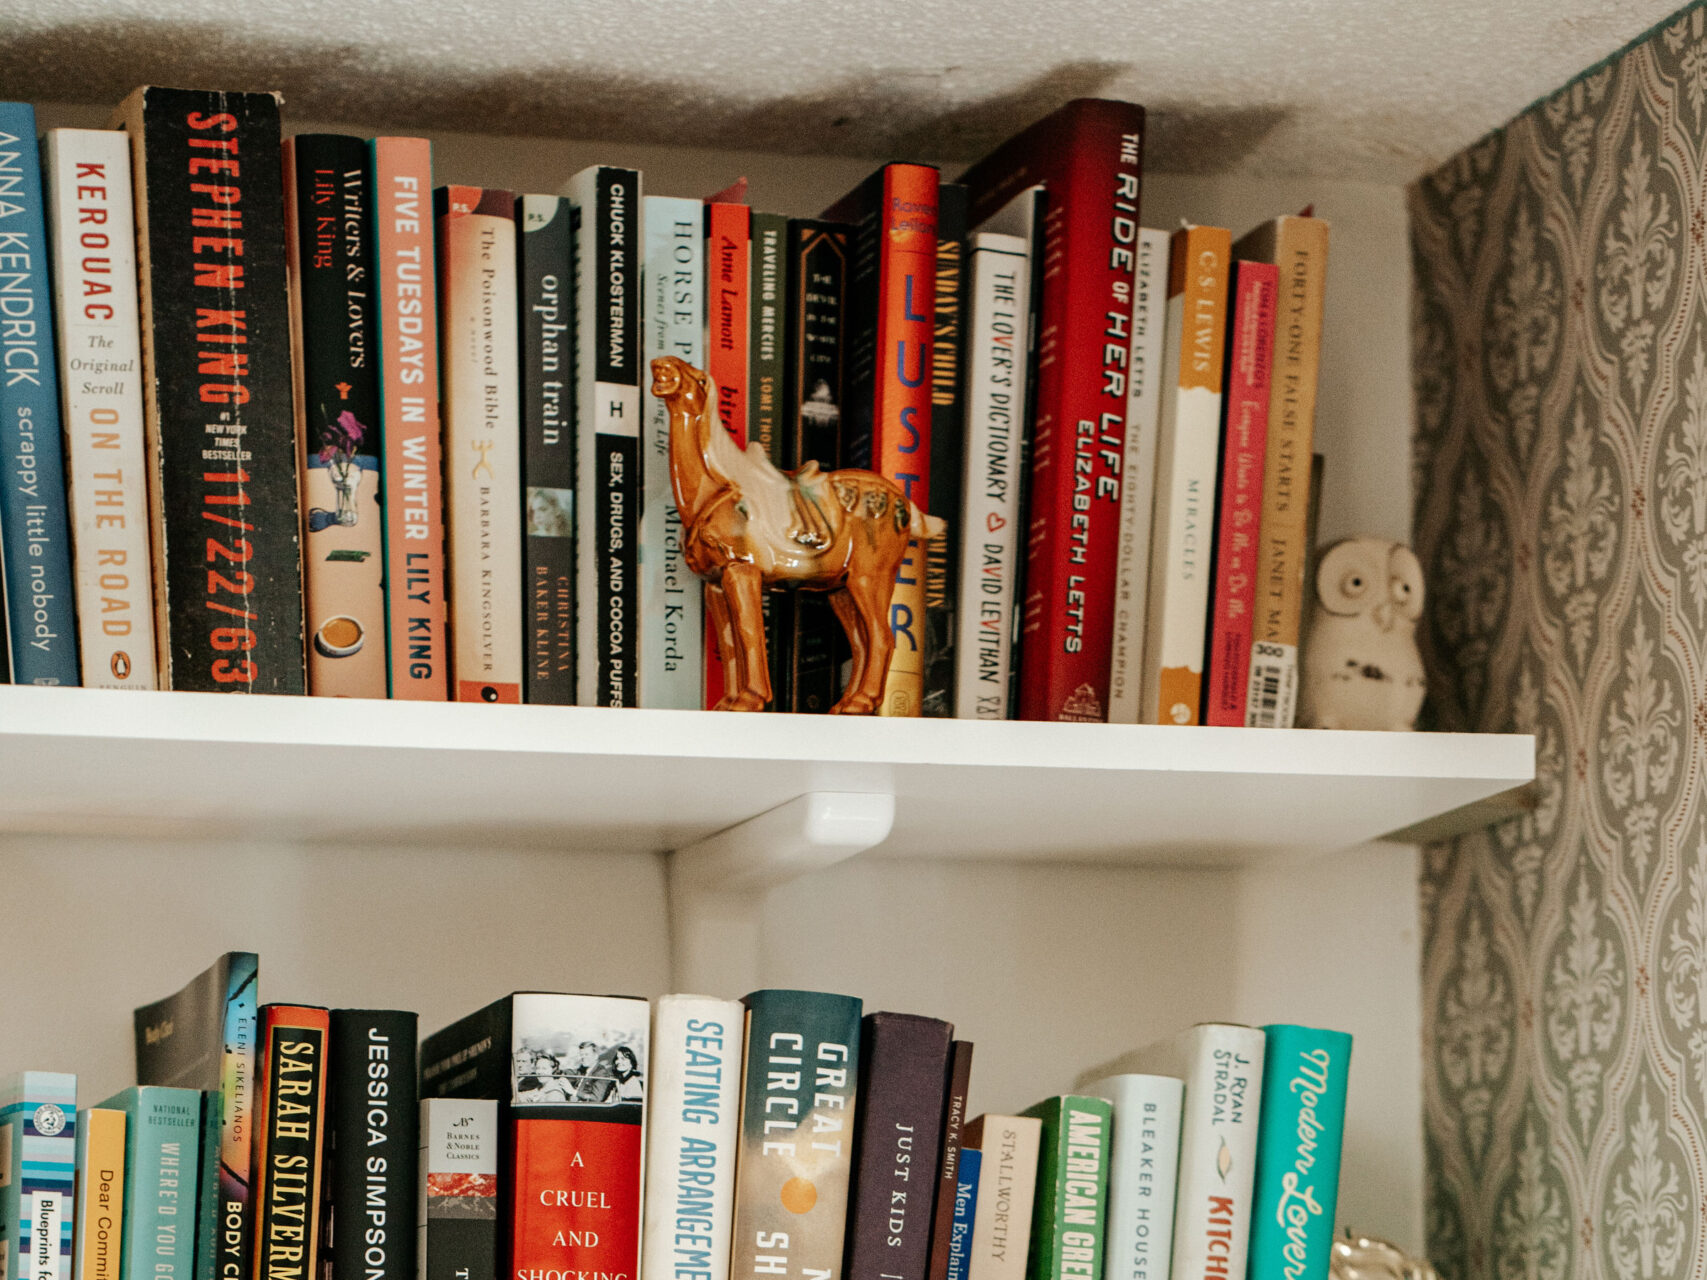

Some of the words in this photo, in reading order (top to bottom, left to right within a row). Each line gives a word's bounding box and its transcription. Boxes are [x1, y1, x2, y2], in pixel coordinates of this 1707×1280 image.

[1120, 134, 1140, 165] THE
[187, 111, 243, 287] STEPHEN
[394, 176, 419, 234] FIVE
[610, 184, 625, 246] CHUCK
[1112, 172, 1139, 273] RIDE
[76, 162, 114, 320] KEROUAC
[761, 230, 777, 301] TRAVELING
[397, 246, 424, 384] TUESDAYS
[610, 250, 625, 367] KLOSTERMAN
[994, 272, 1016, 304] THE
[1112, 281, 1131, 304] OF
[88, 336, 114, 348] The
[533, 274, 567, 372] orphan
[760, 306, 776, 361] MERCIES
[991, 311, 1015, 387] LOVER'S
[1102, 311, 1129, 398] HER
[70, 359, 135, 373] Original
[196, 308, 250, 404] KING
[81, 382, 124, 395] Scroll
[401, 395, 426, 422] IN
[543, 381, 569, 444] train
[16, 407, 38, 497] scrappy
[90, 408, 120, 449] ON
[202, 449, 252, 461] BESTSELLER
[205, 424, 227, 434] NEW
[229, 425, 247, 435] YORK
[214, 436, 240, 447] TIMES
[986, 392, 1011, 503] DICTIONARY
[1097, 412, 1123, 501] LIFE
[94, 469, 126, 529] THE
[402, 436, 429, 540] WINTER
[610, 452, 624, 487] SEX,
[1069, 420, 1095, 565] ELIZABETH
[26, 505, 50, 556] little
[610, 492, 624, 553] DRUGS,
[98, 550, 132, 636] ROAD
[202, 468, 258, 683] 11/22/63
[406, 553, 430, 604] LILY
[610, 557, 624, 591] AND
[981, 543, 1004, 595] DAVID
[31, 565, 57, 651] nobody
[610, 597, 624, 655] COCOA
[1064, 575, 1086, 654] LETTS
[408, 617, 432, 680] KING
[978, 600, 1001, 684] LEVITHAN
[610, 659, 624, 708] PUFFS
[238, 1017, 249, 1052] ELENI
[233, 1062, 245, 1143] SIKELIANOS
[275, 1041, 315, 1142] SARAH
[366, 1027, 390, 1147] JESSICA
[681, 1018, 724, 1125] SEATING
[762, 1031, 804, 1158] CIRCLE
[811, 1041, 849, 1158] GREAT
[1211, 1049, 1232, 1126] STRADAL
[570, 1152, 584, 1167] A
[893, 1122, 914, 1182] JUST
[1062, 1109, 1102, 1226] AMERICAN
[1138, 1102, 1157, 1198] BLEAKER
[100, 1168, 111, 1211] Dear
[540, 1190, 611, 1208] CRUEL
[887, 1189, 907, 1248] KIDS
[955, 1181, 972, 1217] Men
[37, 1199, 54, 1267] Blueprints
[223, 1201, 244, 1257] BODY
[552, 1230, 599, 1248] AND
[1132, 1208, 1151, 1280] HOUSE
